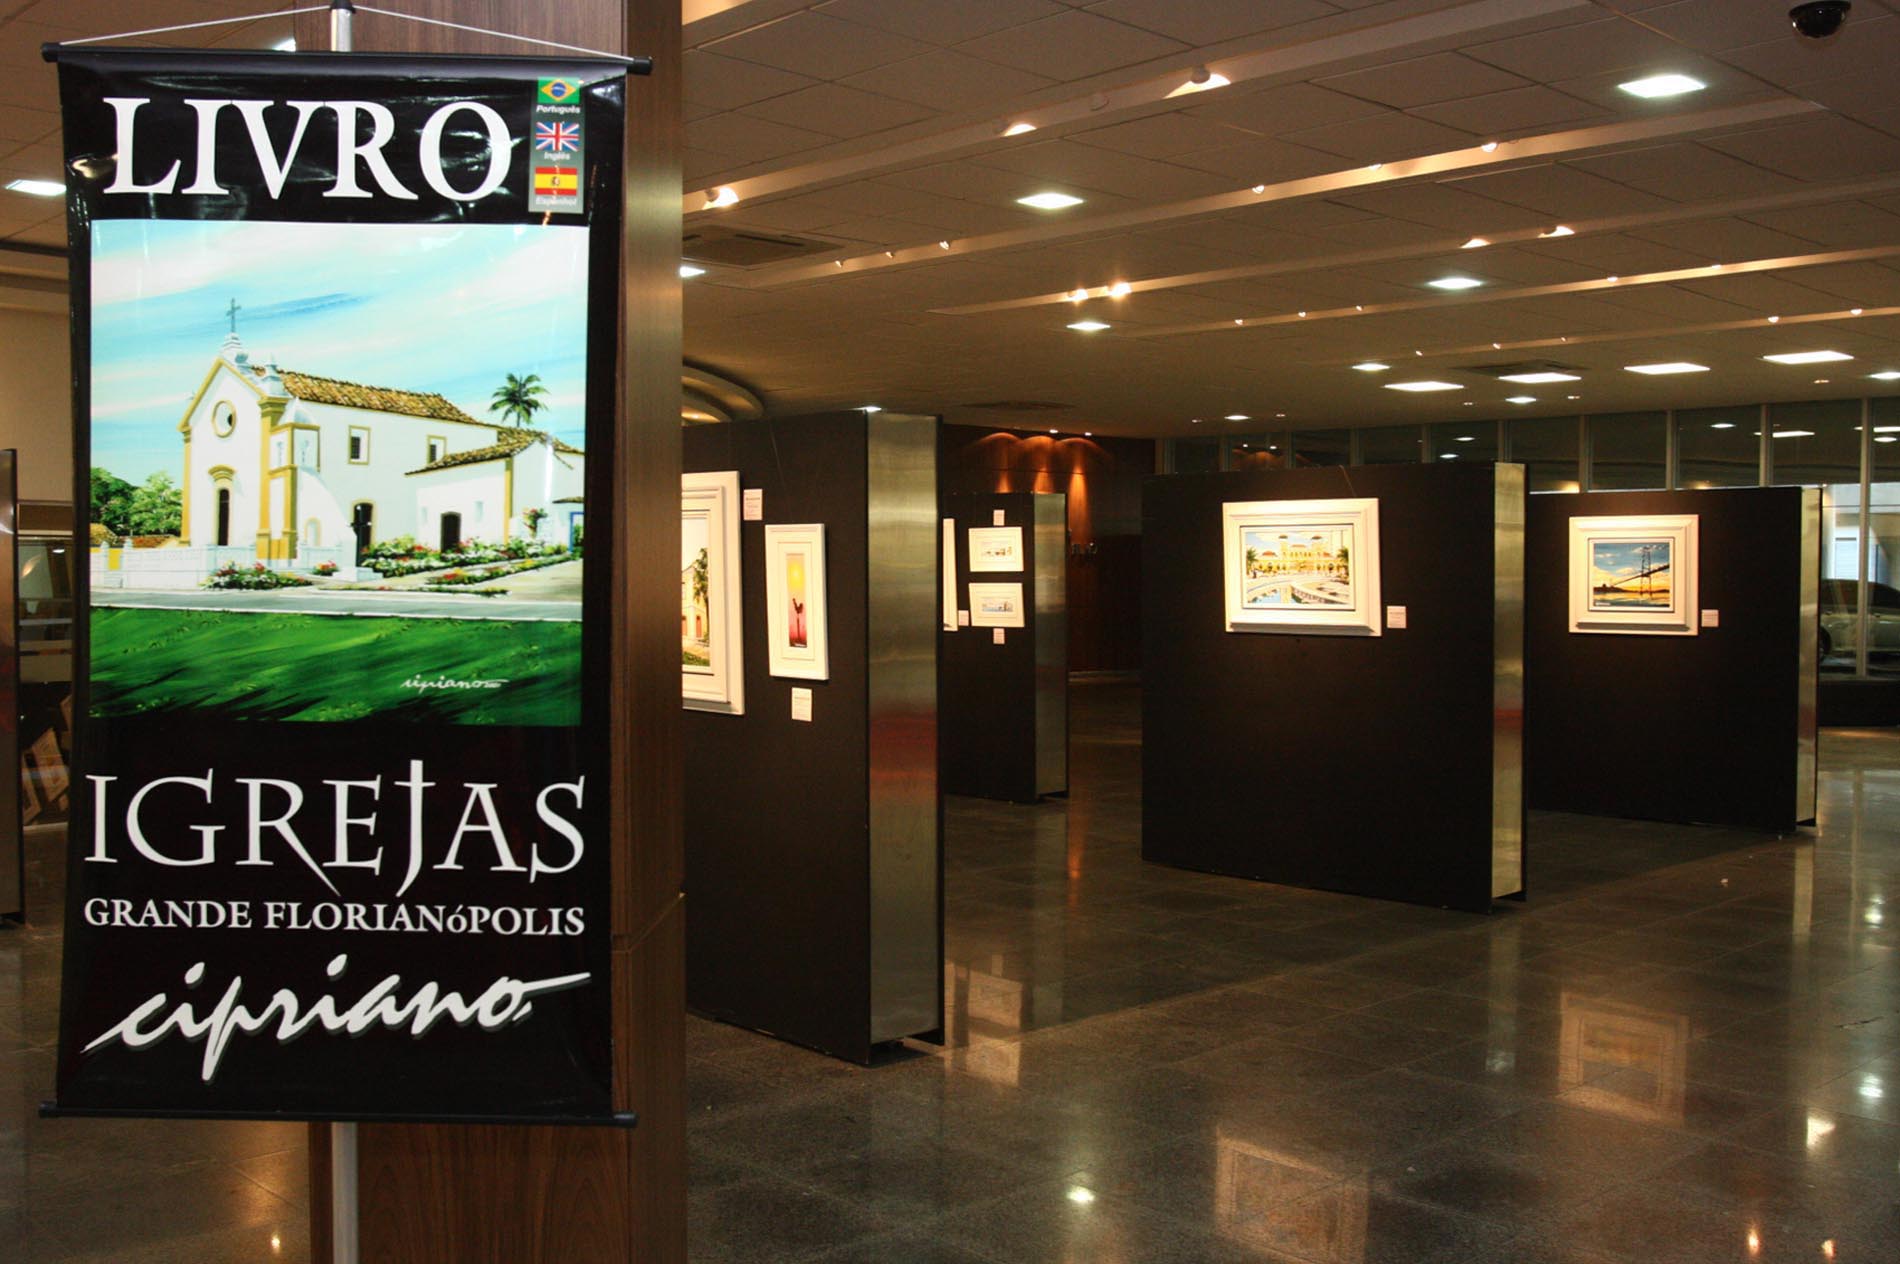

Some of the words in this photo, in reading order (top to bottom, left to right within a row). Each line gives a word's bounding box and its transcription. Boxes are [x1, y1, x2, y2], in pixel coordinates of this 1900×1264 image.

[536, 104, 581, 114] Português
[103, 97, 513, 201] LIVRO
[544, 152, 571, 161] Inglês
[84, 759, 586, 898] IGREJAS
[84, 898, 252, 929] GRANDE
[81, 954, 591, 1083] cipriano
